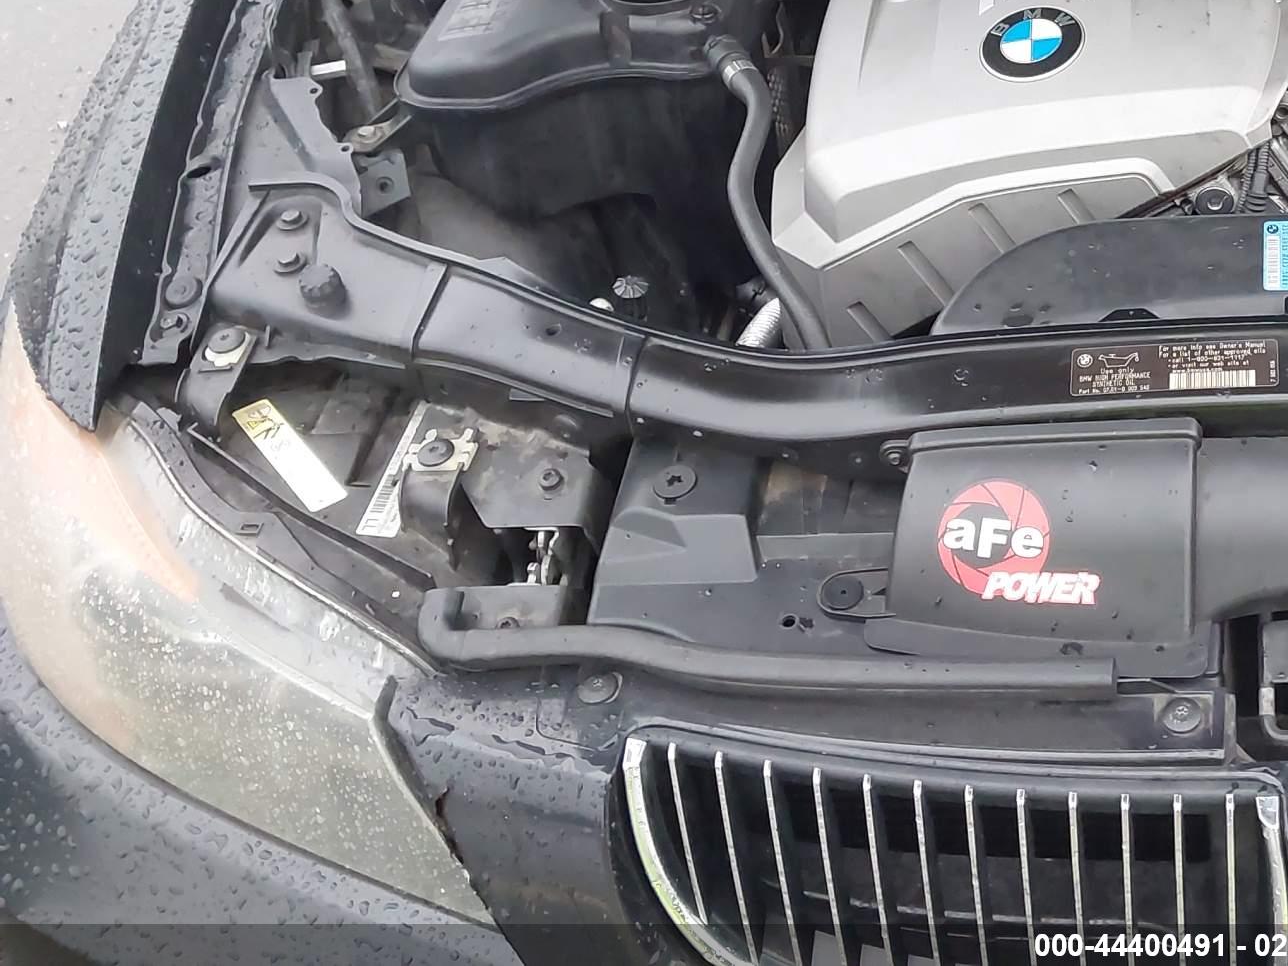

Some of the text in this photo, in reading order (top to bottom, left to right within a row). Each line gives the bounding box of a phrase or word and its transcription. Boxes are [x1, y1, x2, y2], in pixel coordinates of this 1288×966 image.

[990, 8, 1076, 36] BMW
[1117, 366, 1135, 376] only
[943, 517, 1044, 559] aFe
[981, 571, 1100, 605] POWER
